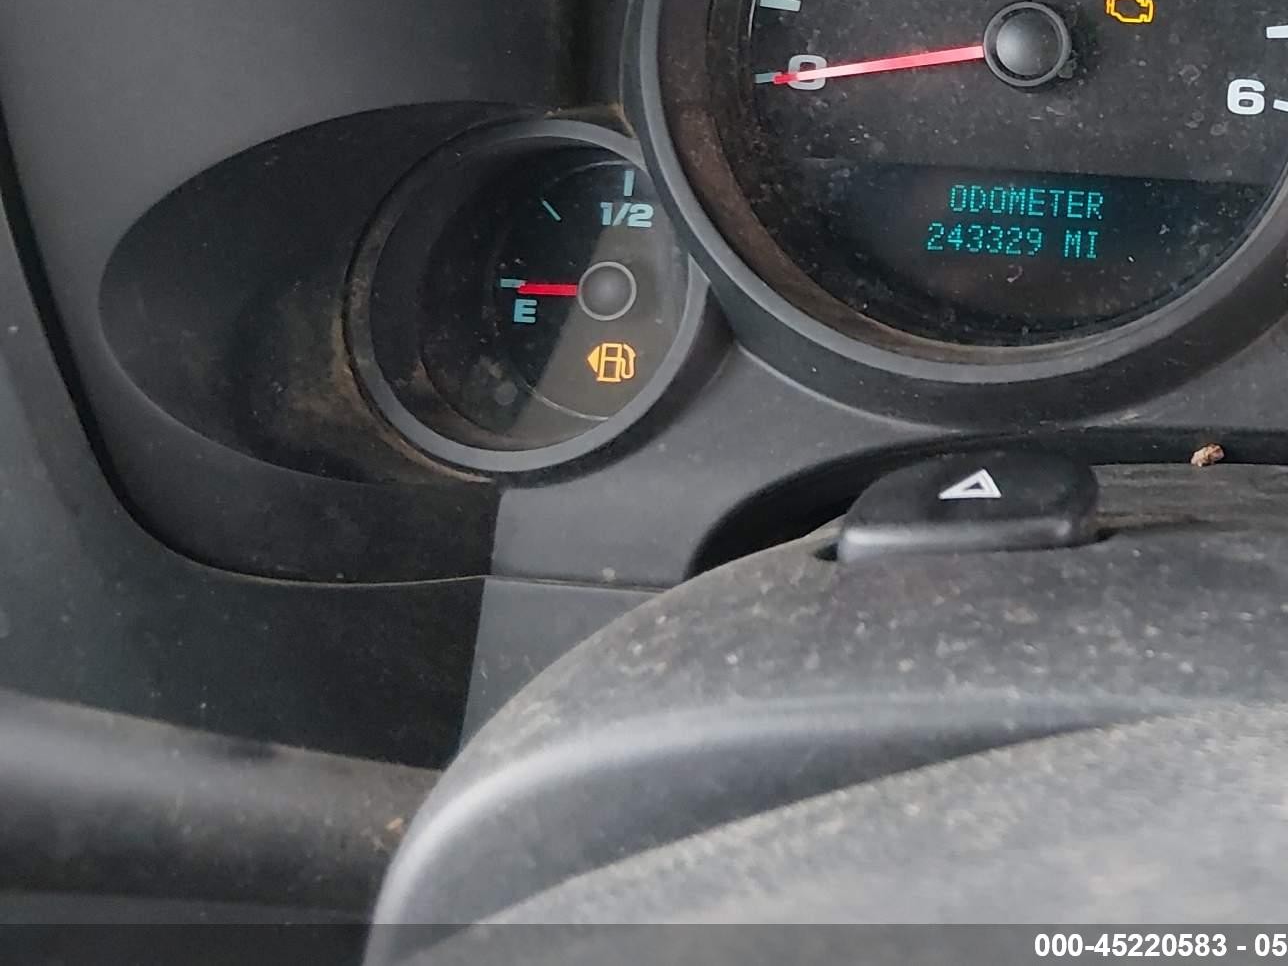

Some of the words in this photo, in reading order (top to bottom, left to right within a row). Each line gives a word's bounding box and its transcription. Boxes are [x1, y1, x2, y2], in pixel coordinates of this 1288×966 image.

[1227, 79, 1265, 115] 6
[600, 202, 654, 228] 1/2
[949, 184, 1104, 218] ODOMETER
[926, 222, 1043, 254] 243329
[1064, 231, 1099, 259] MI
[513, 298, 538, 324] E
